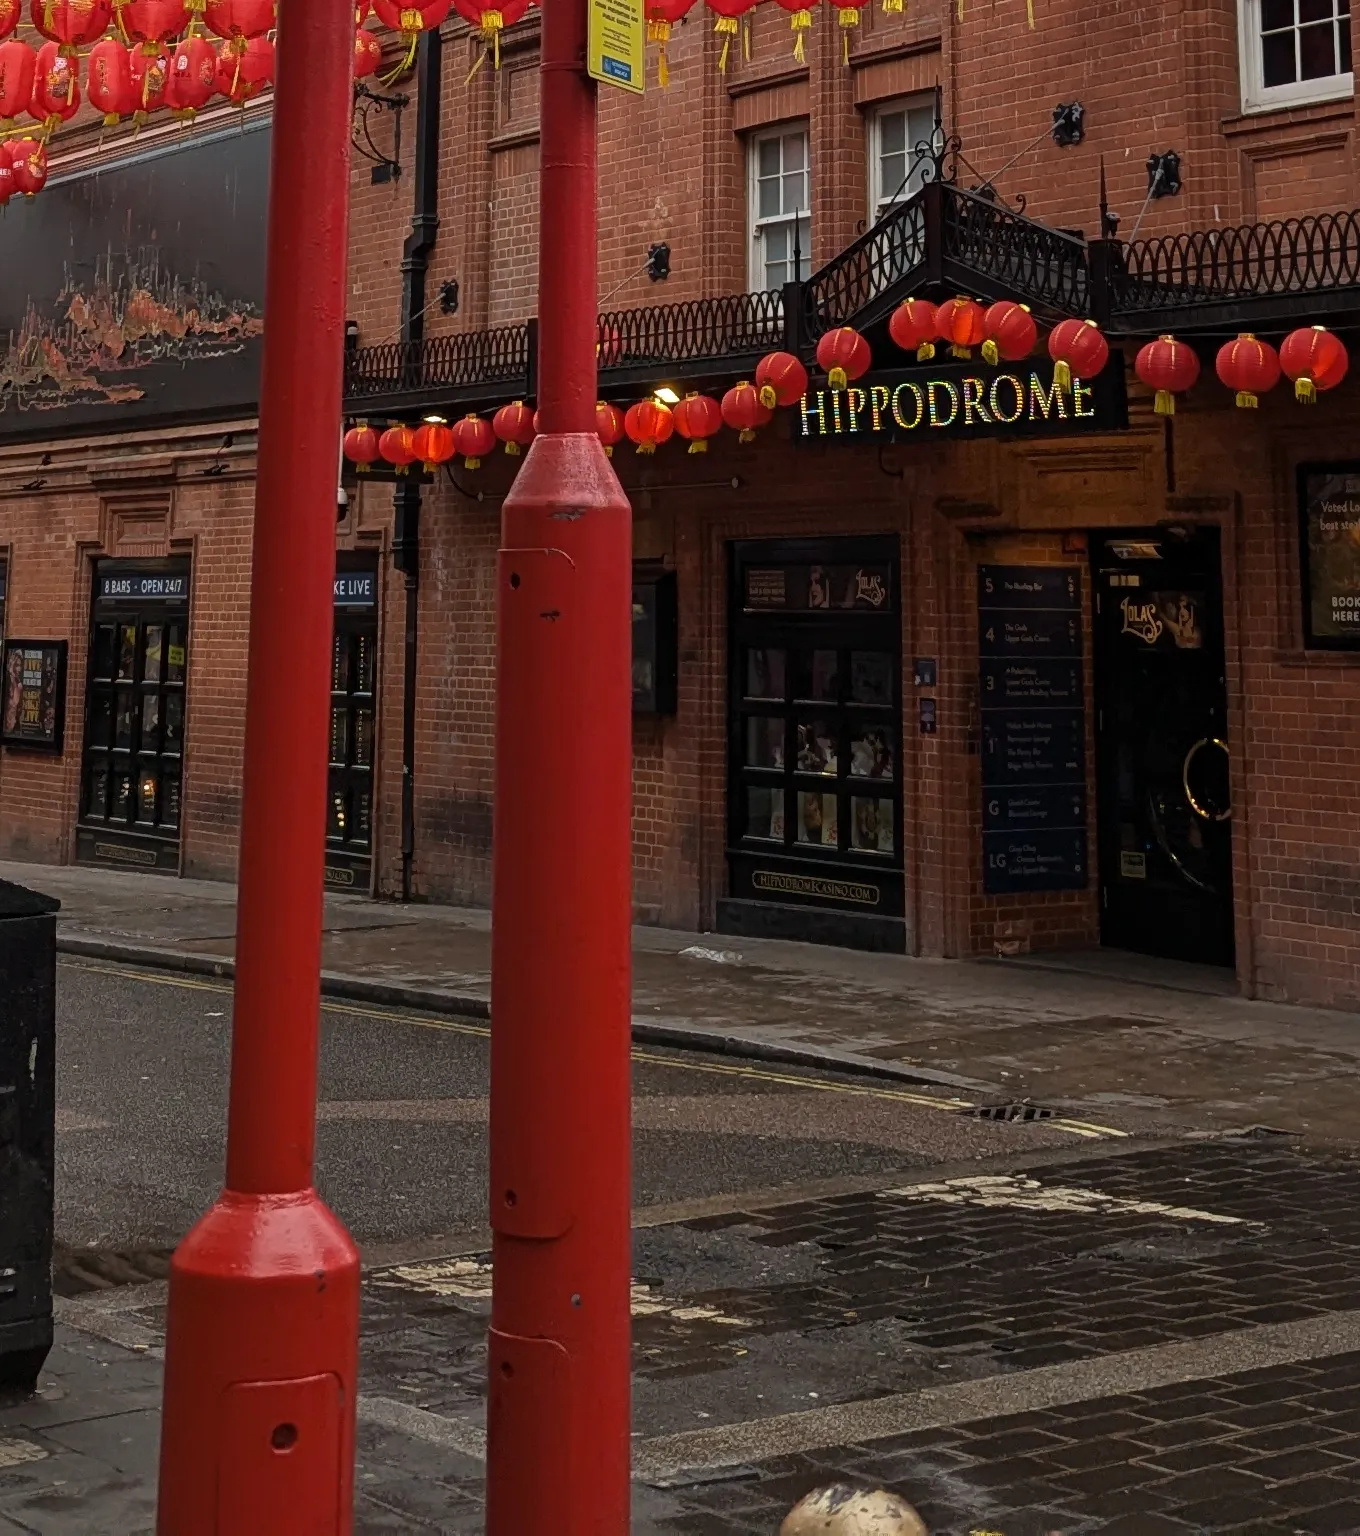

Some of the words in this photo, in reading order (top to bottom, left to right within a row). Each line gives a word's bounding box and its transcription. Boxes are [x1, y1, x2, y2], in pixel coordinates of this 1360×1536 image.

[800, 371, 1095, 436] HIPPODROME
[1321, 500, 1348, 513] Voted
[1320, 517, 1339, 531] best
[104, 580, 110, 594] 8
[111, 580, 131, 594] BARS
[141, 579, 163, 594] OPEN
[164, 579, 182, 594] 24/7
[348, 579, 371, 595] LIVE
[985, 577, 994, 593] 5
[1332, 610, 1360, 623] HERE
[985, 627, 995, 642] 4
[986, 675, 995, 691] 3
[988, 800, 1000, 816] G
[989, 853, 1007, 869] LG
[759, 874, 871, 901] HIPPODROMECASINO.COM
